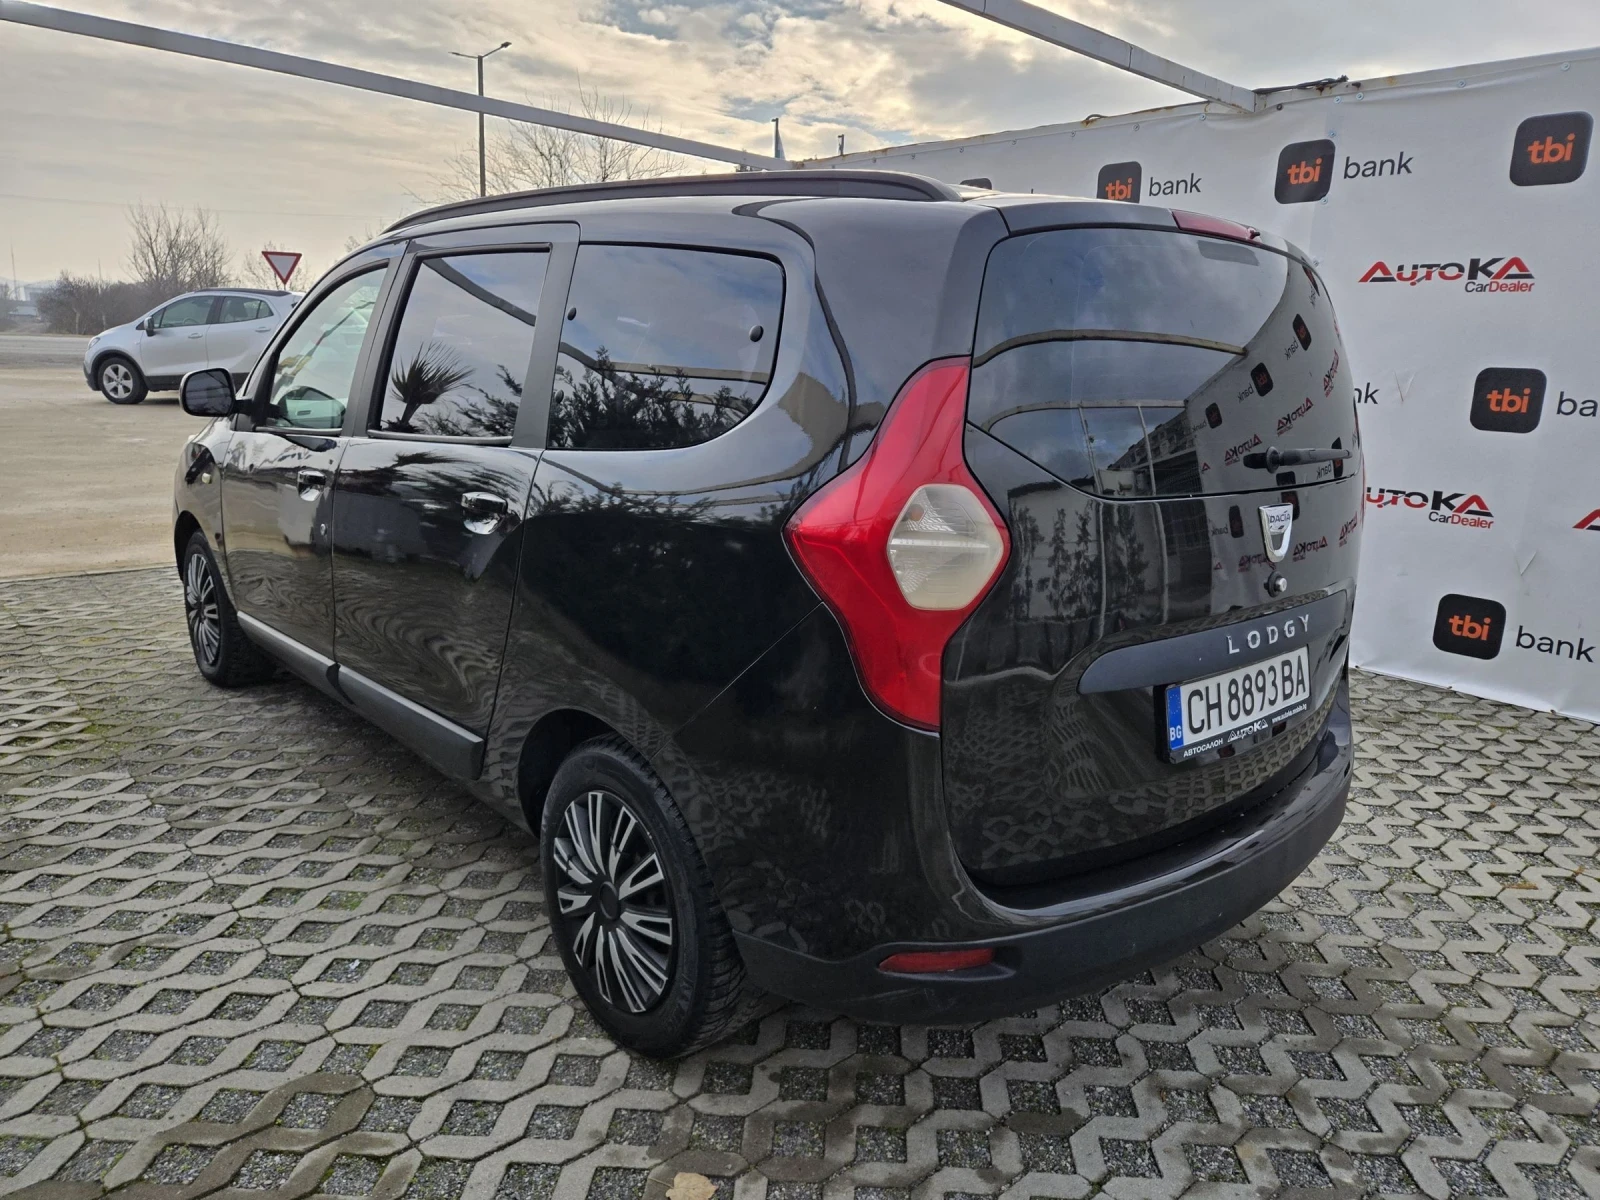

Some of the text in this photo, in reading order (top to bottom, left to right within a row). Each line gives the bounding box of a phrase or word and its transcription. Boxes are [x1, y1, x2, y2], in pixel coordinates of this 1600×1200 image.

[1527, 132, 1576, 166] tbi
[1287, 151, 1415, 186] tbi bank
[1105, 173, 1202, 201] tbi bank
[1464, 279, 1535, 293] CarDealer
[1353, 382, 1380, 405] nk
[1486, 387, 1598, 418] tbi ba
[1365, 486, 1494, 518] UTOKA
[1269, 513, 1291, 524] DACIA
[1428, 510, 1494, 529] CarDealer
[1226, 613, 1310, 655] LODGY
[1448, 614, 1597, 663] tbi bank
[1169, 724, 1182, 742] BG
[1182, 737, 1224, 758] АВТОСАЛОН
